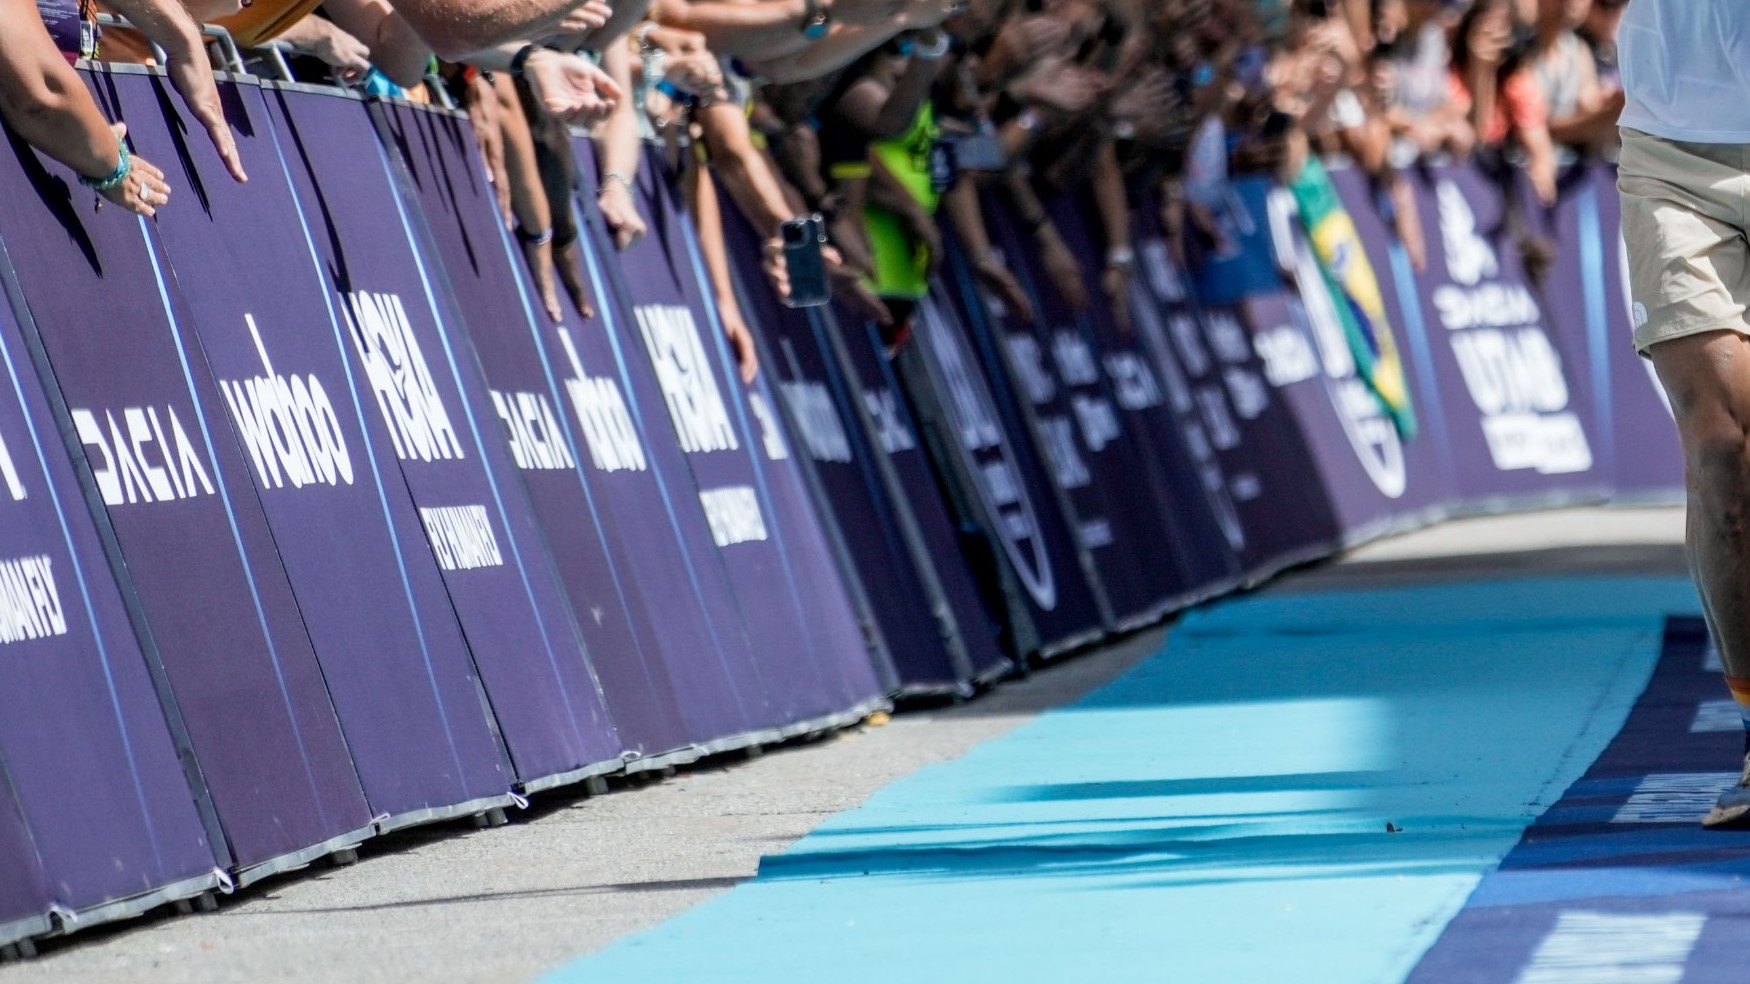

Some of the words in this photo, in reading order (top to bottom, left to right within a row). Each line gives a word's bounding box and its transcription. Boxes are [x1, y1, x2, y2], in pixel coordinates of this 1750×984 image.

[219, 313, 354, 489] wahoo
[337, 290, 464, 462] HOKA
[489, 389, 575, 469] DACIA
[71, 404, 216, 506] DACIA
